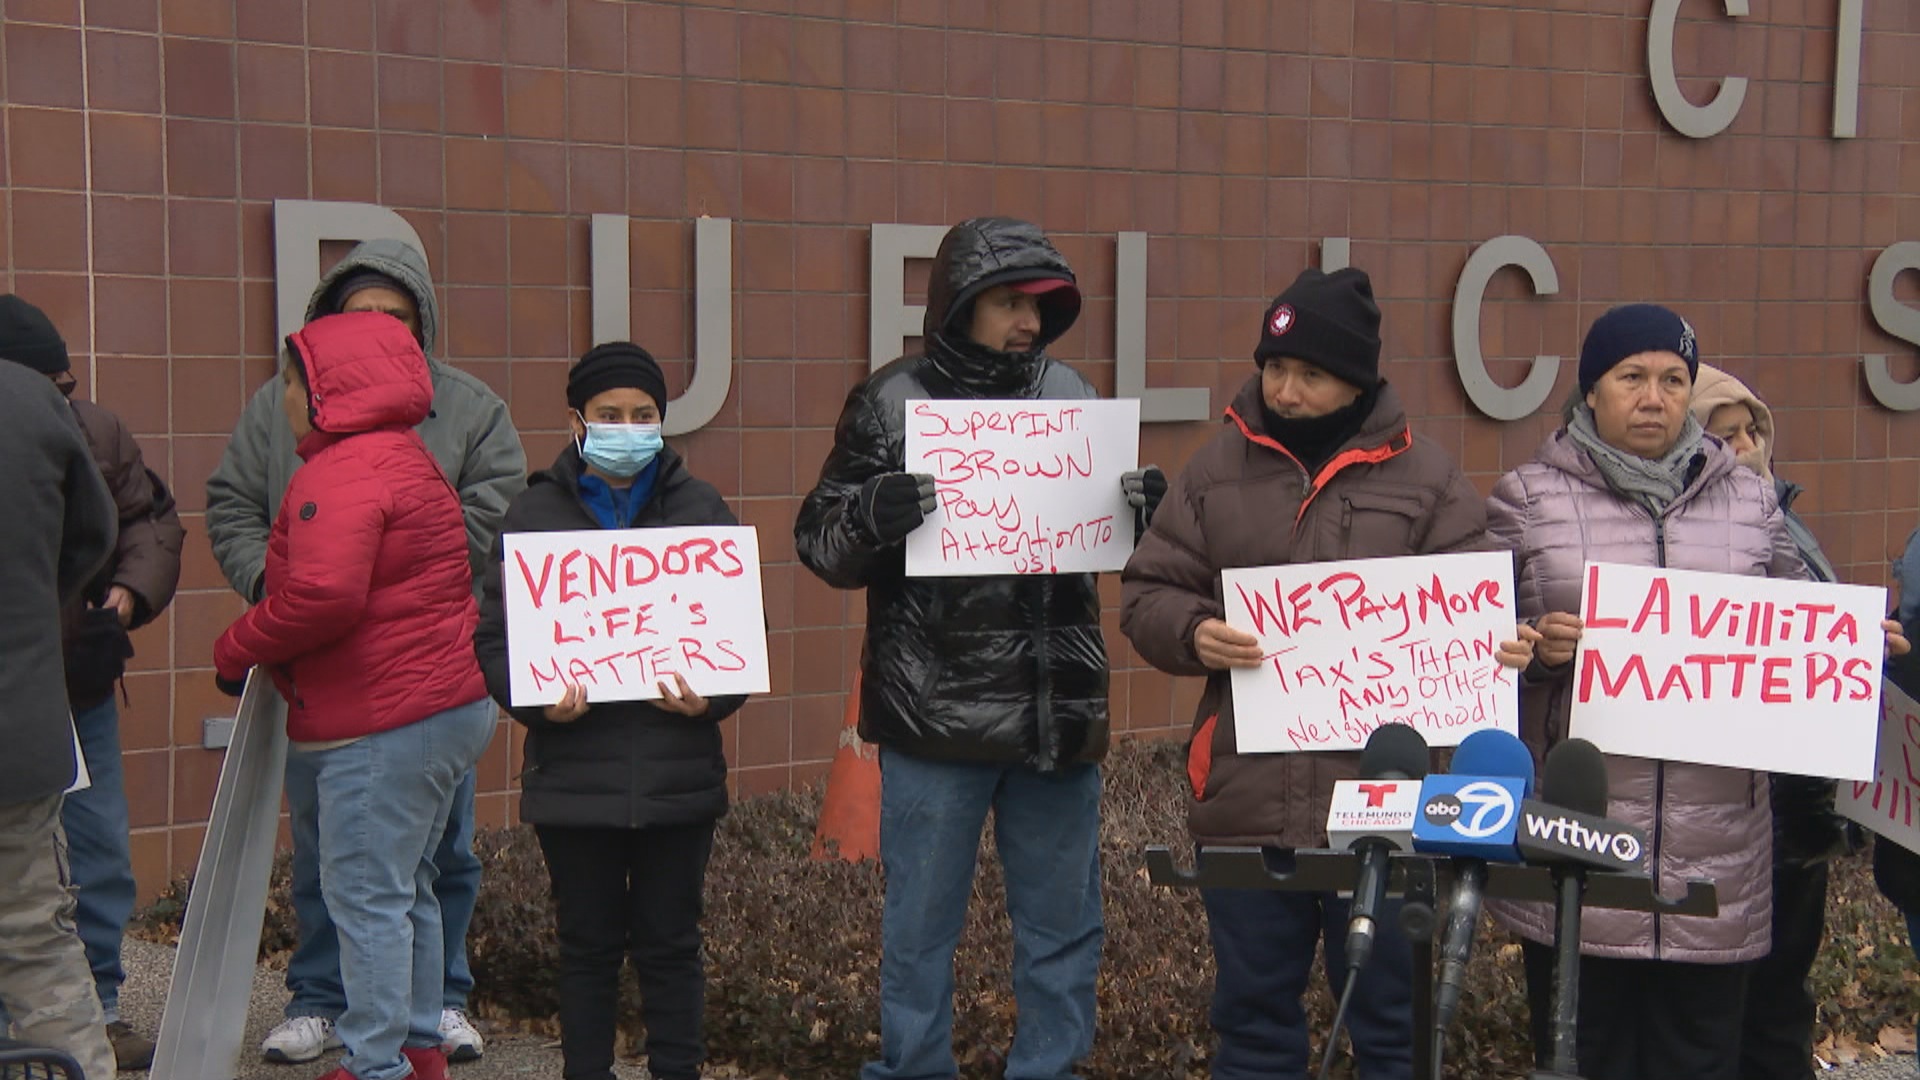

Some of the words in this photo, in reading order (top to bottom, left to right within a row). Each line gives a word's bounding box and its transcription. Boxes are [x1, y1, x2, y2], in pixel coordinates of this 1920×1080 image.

[936, 488, 1022, 532] Pay
[514, 538, 744, 609] VENDORS
[1584, 562, 1670, 635] LA
[1235, 578, 1322, 638] WE
[529, 637, 746, 691] MATTERS
[1398, 630, 1494, 676] THAN
[1579, 649, 1873, 704] MATTERS
[1418, 663, 1511, 700] OTHER
[1335, 811, 1413, 820] TELEMUNDO
[1341, 818, 1403, 826] CHICAGO
